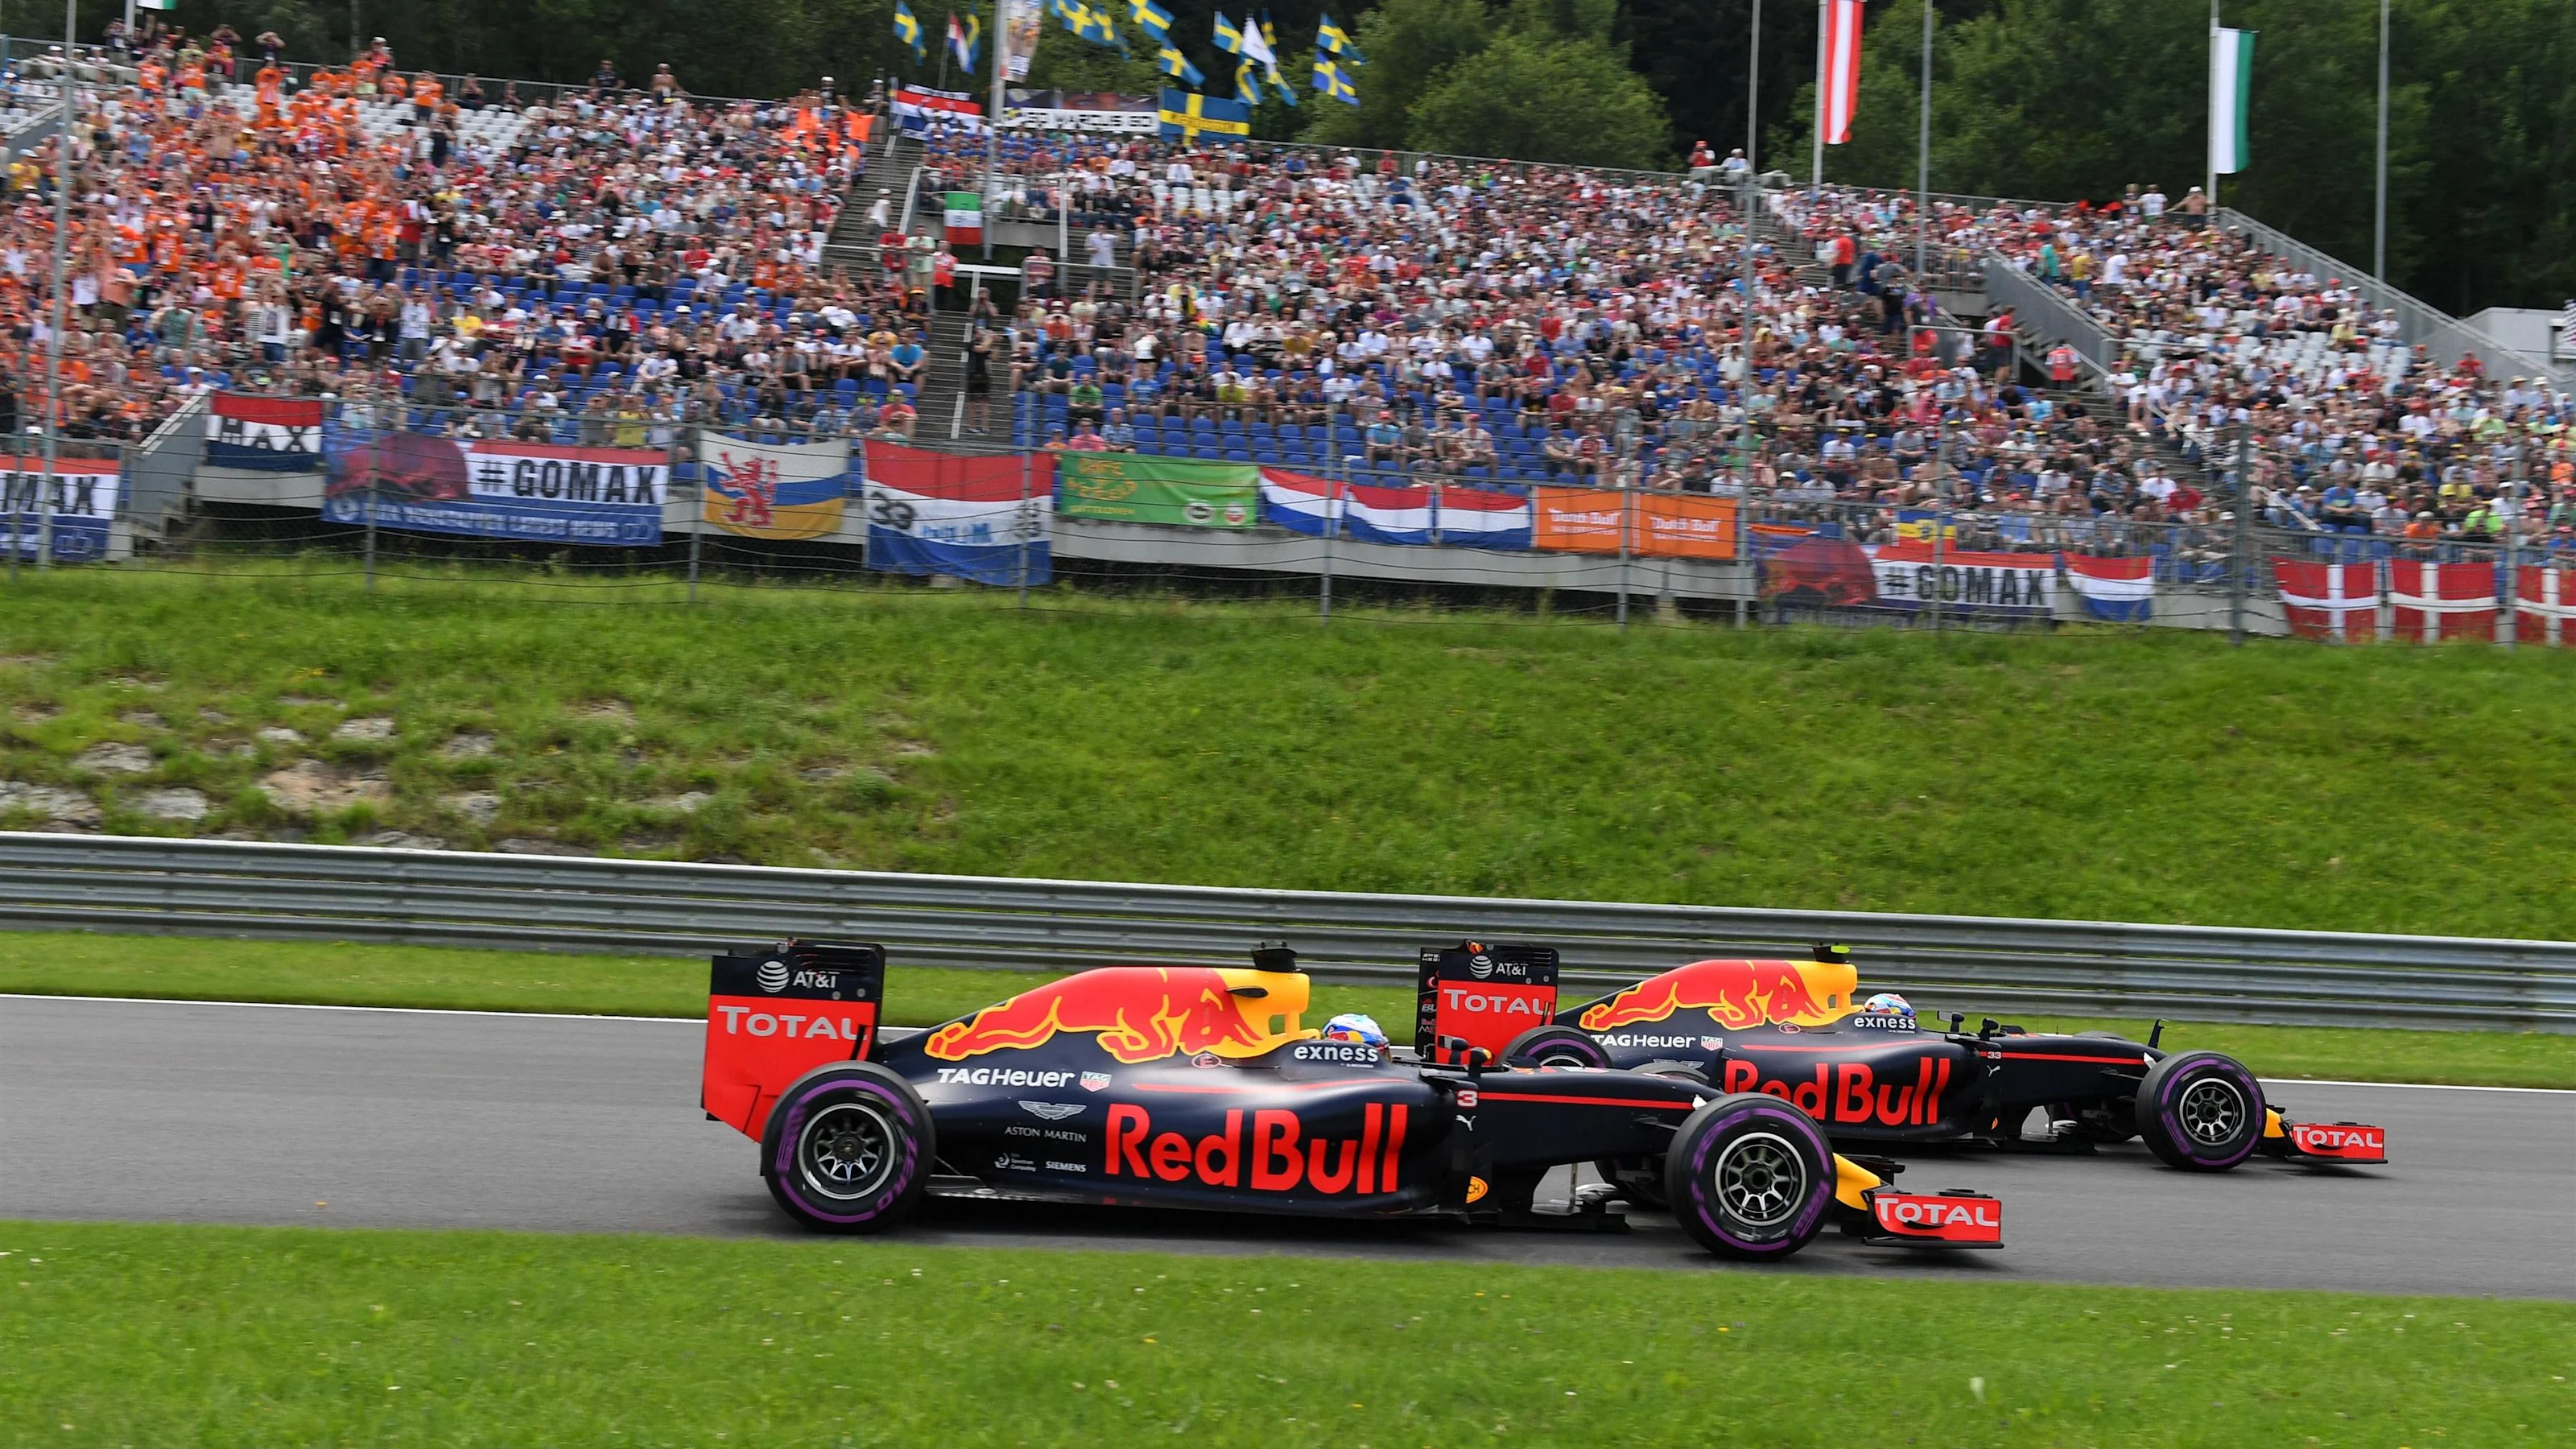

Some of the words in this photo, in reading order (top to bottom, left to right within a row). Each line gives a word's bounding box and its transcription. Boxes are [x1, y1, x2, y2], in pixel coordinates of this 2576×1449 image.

[479, 458, 658, 506] #GOMAX
[1884, 564, 2045, 606] #GOMAX
[1496, 962, 1529, 976] AT&T
[792, 971, 840, 989] AT&T
[1443, 989, 1550, 1016] TOTAL
[716, 1005, 868, 1041] TOTAL
[1854, 1017, 1916, 1030] exness
[1294, 1046, 1379, 1063] exness
[1987, 1051, 2002, 1059] 33
[1457, 1090, 1478, 1107] 3
[1005, 1126, 1040, 1137] ASTON
[1044, 1129, 1087, 1142] MARTIN
[2293, 1126, 2384, 1148] TOTAL
[1105, 1103, 1243, 1187] Red
[1250, 1103, 1408, 1195] Bull
[1046, 1160, 1087, 1172] SIEMENS
[1875, 1197, 1999, 1227] TOTAL
